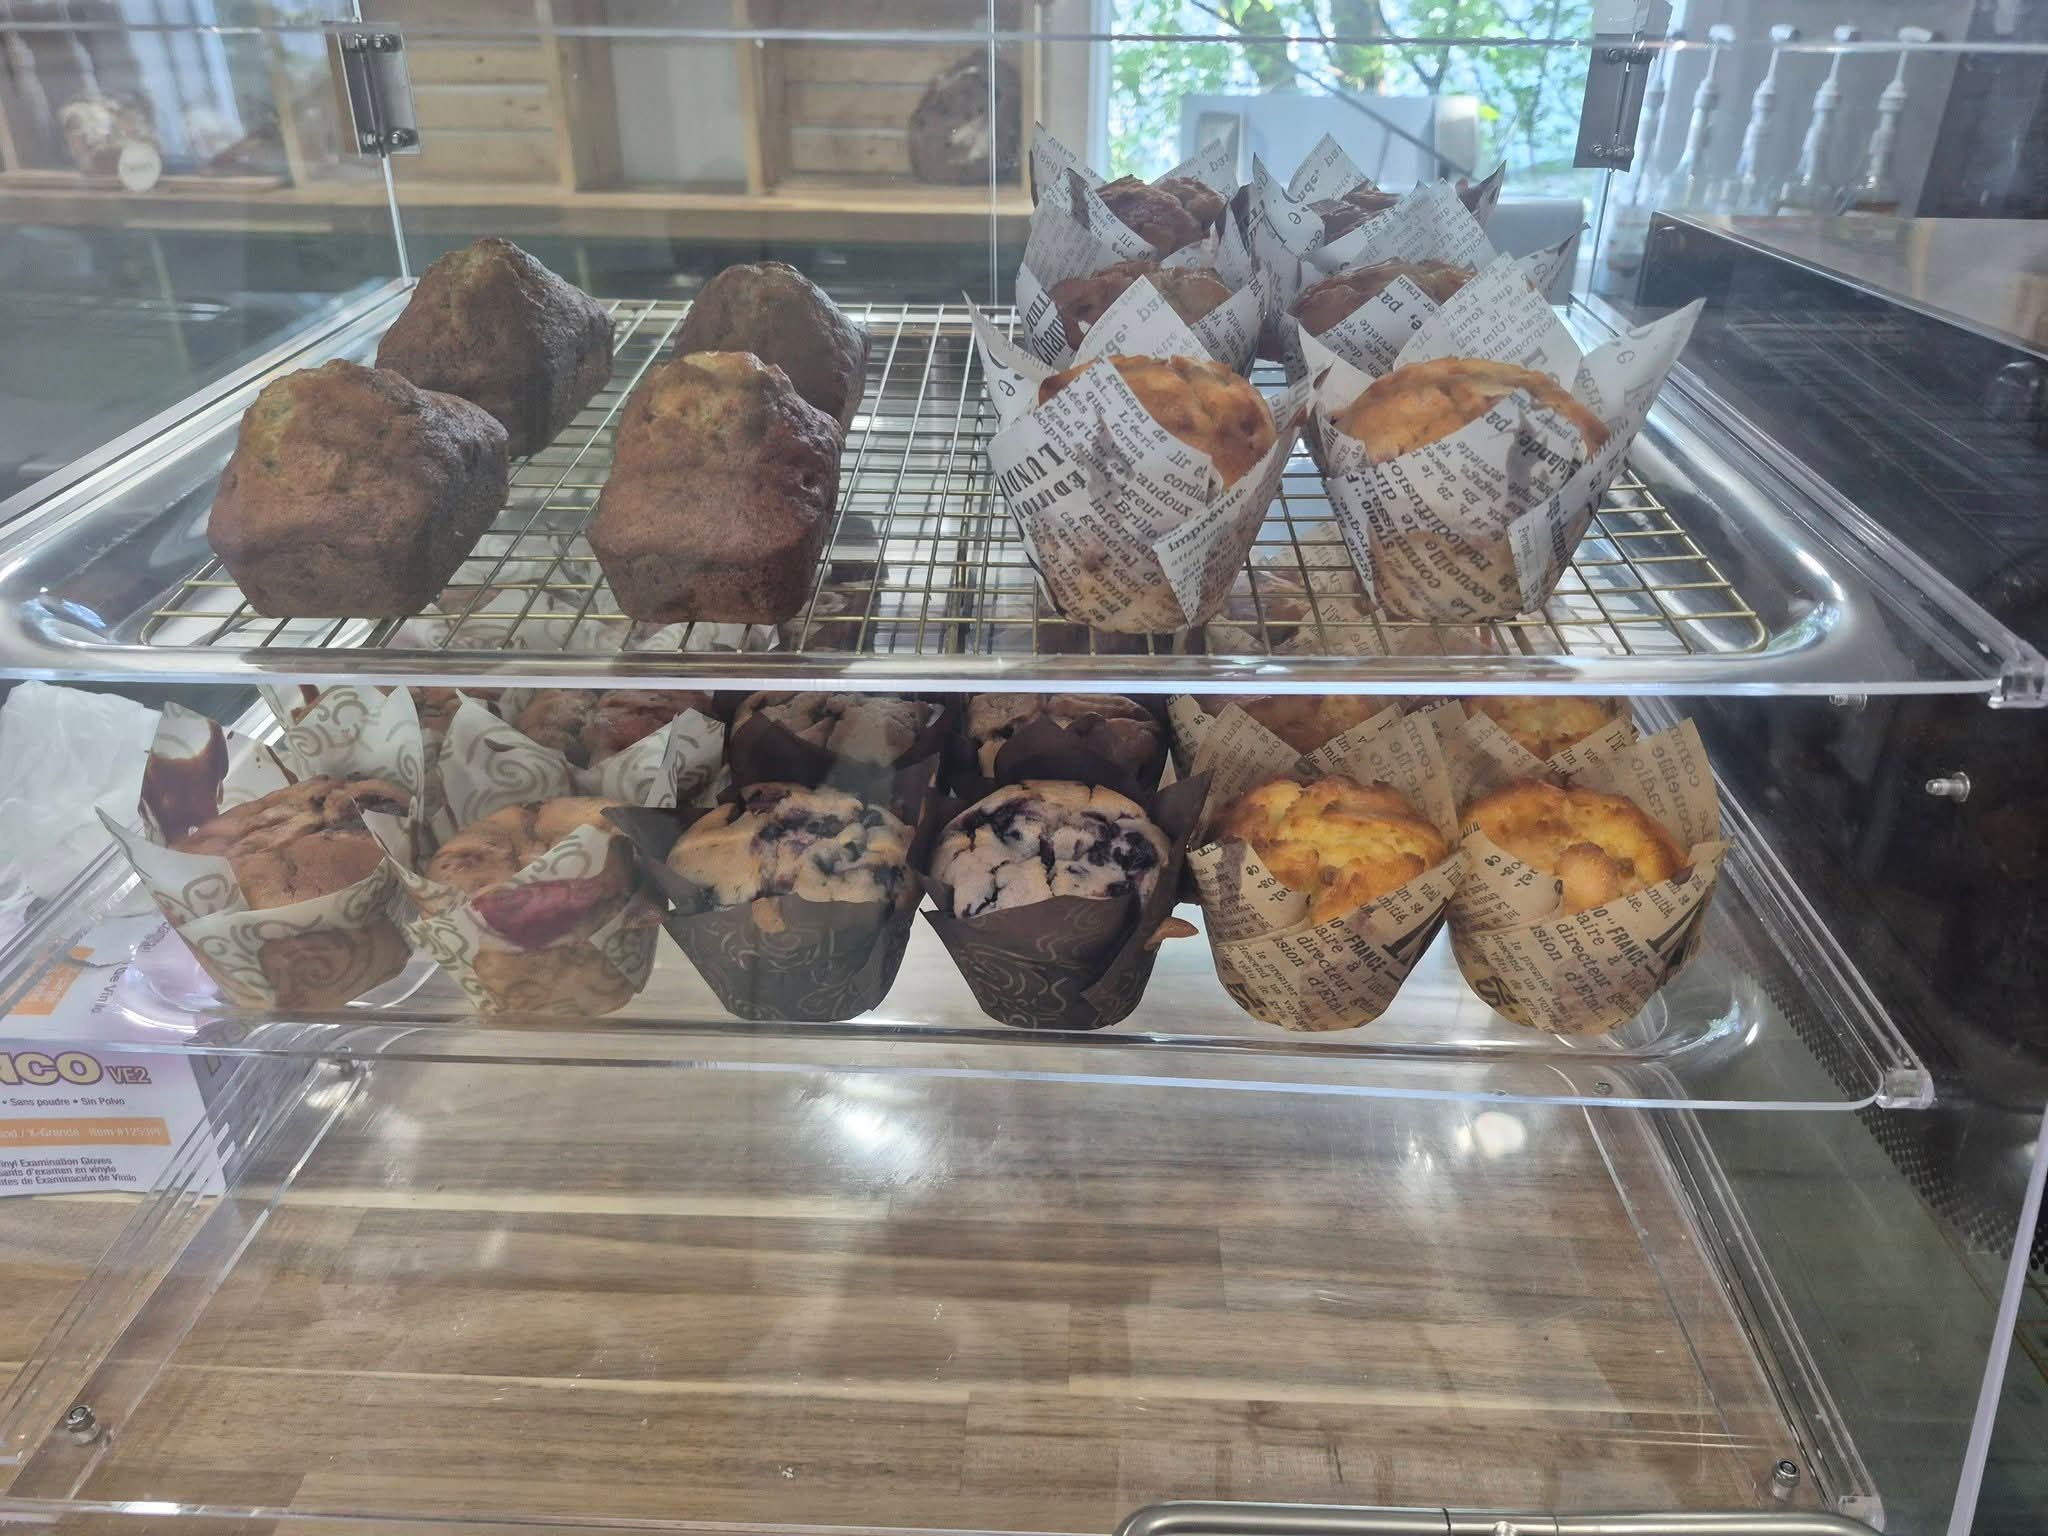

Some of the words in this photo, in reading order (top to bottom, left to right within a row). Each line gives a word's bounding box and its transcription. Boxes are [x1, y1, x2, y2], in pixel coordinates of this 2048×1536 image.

[1083, 389, 1109, 416] que
[1110, 421, 1146, 460] forma
[1152, 426, 1170, 443] de
[1453, 439, 1505, 485] serviette
[1418, 463, 1434, 479] le
[1460, 487, 1480, 506] En
[1396, 511, 1419, 536] le
[1079, 512, 1138, 568] général
[1142, 569, 1162, 589] de
[1484, 852, 1502, 869] ce
[1244, 862, 1261, 879] ce
[1555, 919, 1617, 992] directeur
[1607, 951, 1625, 967] à
[1296, 933, 1354, 996] directeur
[1265, 961, 1298, 999] premier
[1520, 953, 1554, 994] premier
[1269, 982, 1283, 997] un
[1524, 976, 1538, 992] un
[105, 1066, 152, 1085] VE2
[10, 1098, 35, 1106] Sans
[37, 1097, 70, 1107] poudre
[81, 1097, 98, 1106] Sin
[20, 1158, 78, 1167] Examination
[81, 1157, 112, 1165] Gloves
[26, 1166, 72, 1176] d'examen
[89, 1165, 117, 1176] vinyle
[21, 1176, 34, 1185] de
[35, 1174, 97, 1184] Examinación
[98, 1173, 110, 1182] de
